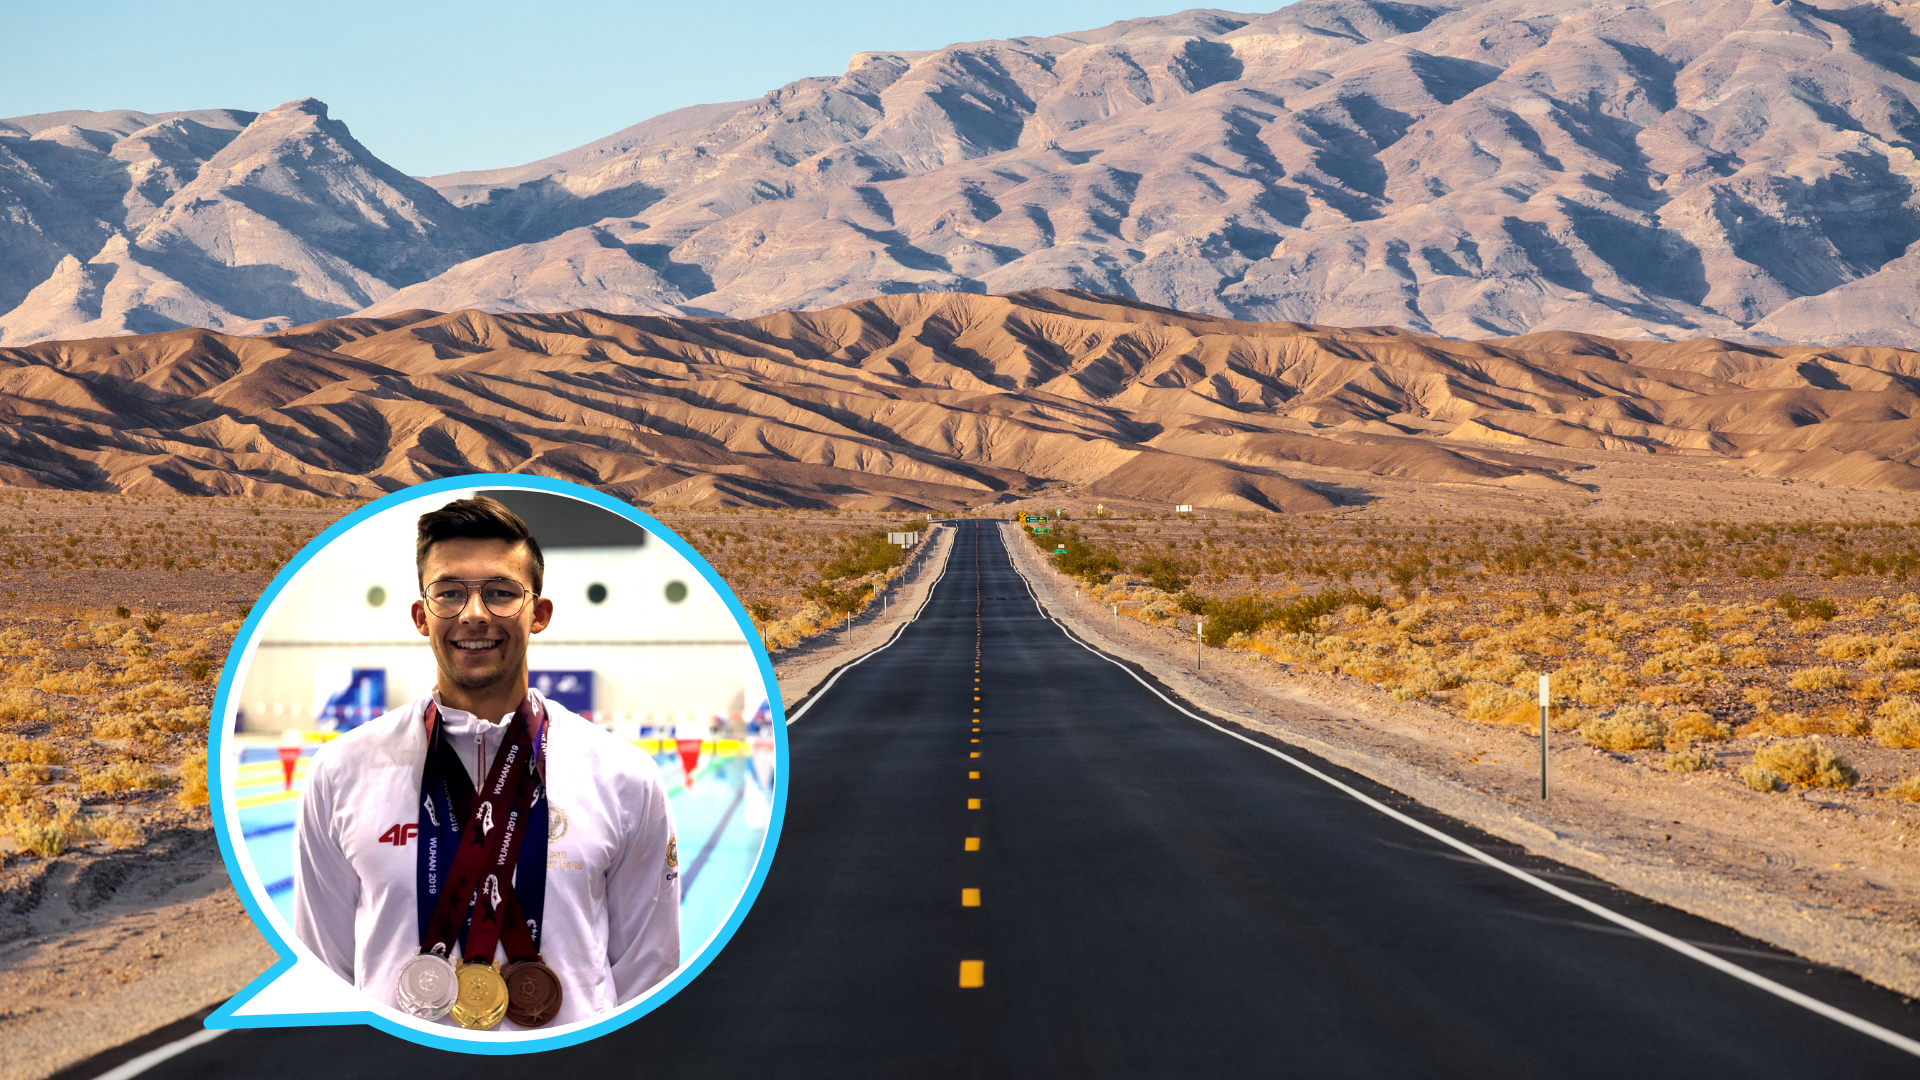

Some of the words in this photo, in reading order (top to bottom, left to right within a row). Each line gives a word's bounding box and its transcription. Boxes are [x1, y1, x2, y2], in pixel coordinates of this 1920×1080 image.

[493, 764, 511, 795] WUHAN
[506, 744, 519, 764] 2019
[378, 823, 419, 847] 4F
[497, 832, 512, 866] WUHAN
[506, 811, 518, 832] 2019
[428, 837, 437, 871] WUHAN
[547, 850, 566, 859] ISH
[559, 861, 583, 870] TEAM
[428, 873, 437, 895] 2019
